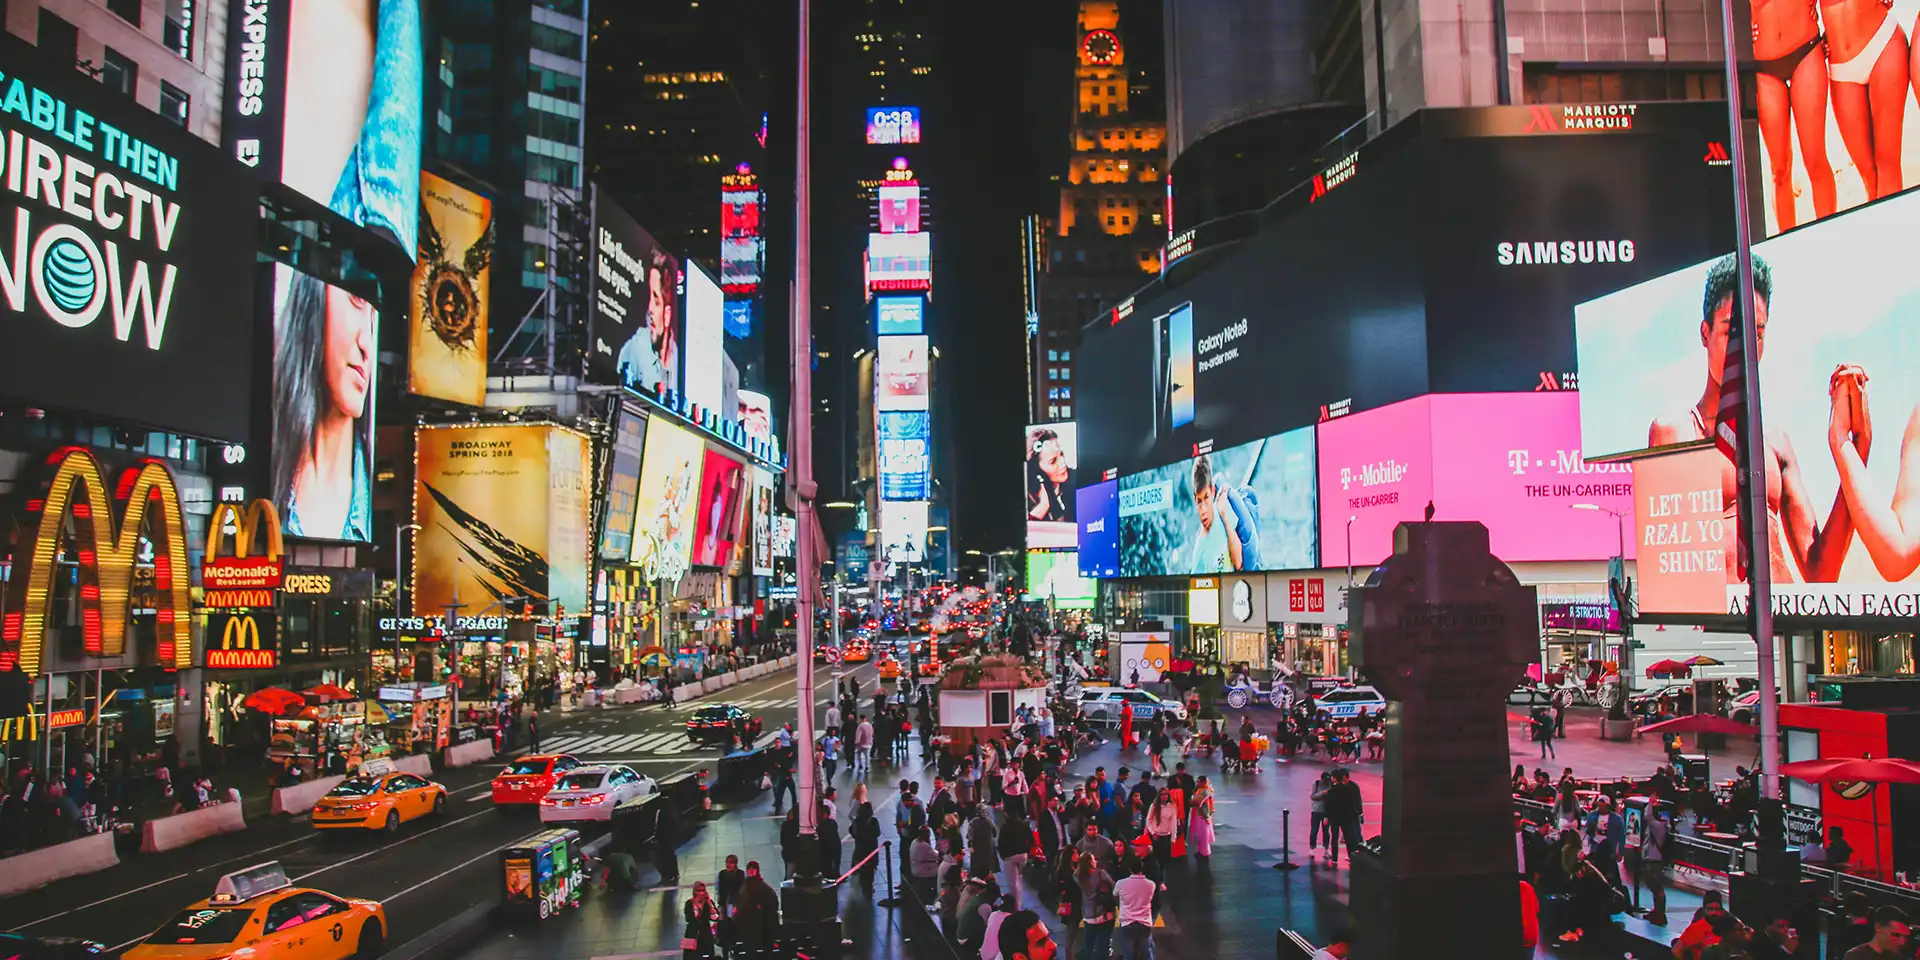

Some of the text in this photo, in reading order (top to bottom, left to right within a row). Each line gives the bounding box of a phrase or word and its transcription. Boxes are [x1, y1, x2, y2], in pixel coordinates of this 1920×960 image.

[874, 111, 913, 127] 0:38
[1563, 104, 1637, 117] MARRIOTT
[0, 71, 178, 191] ABLE THEN
[1565, 116, 1630, 129] MARQUIS
[1326, 151, 1359, 180] MARRIOTT
[1326, 164, 1356, 191] MARQUIS
[0, 128, 181, 252] IRECTV
[1496, 240, 1636, 266] SAMSUNG
[872, 279, 929, 290] TOSHIBA
[1198, 318, 1248, 355] Galaxy Note8
[1199, 348, 1239, 373] Pre-order now.
[451, 440, 512, 449] BROADWAY
[449, 450, 488, 458] SPRING
[1137, 487, 1163, 506] LEADERS
[1525, 484, 1632, 497] THE UN-CARRIER
[1349, 492, 1399, 508] THE UN-CARRIER
[1649, 493, 1684, 518] LET
[1644, 523, 1692, 546] REAL
[204, 565, 279, 578] McDonald's
[216, 578, 266, 586] Restaurant
[1730, 593, 1852, 616] AERICAN
[434, 617, 509, 630] LGGAGE
